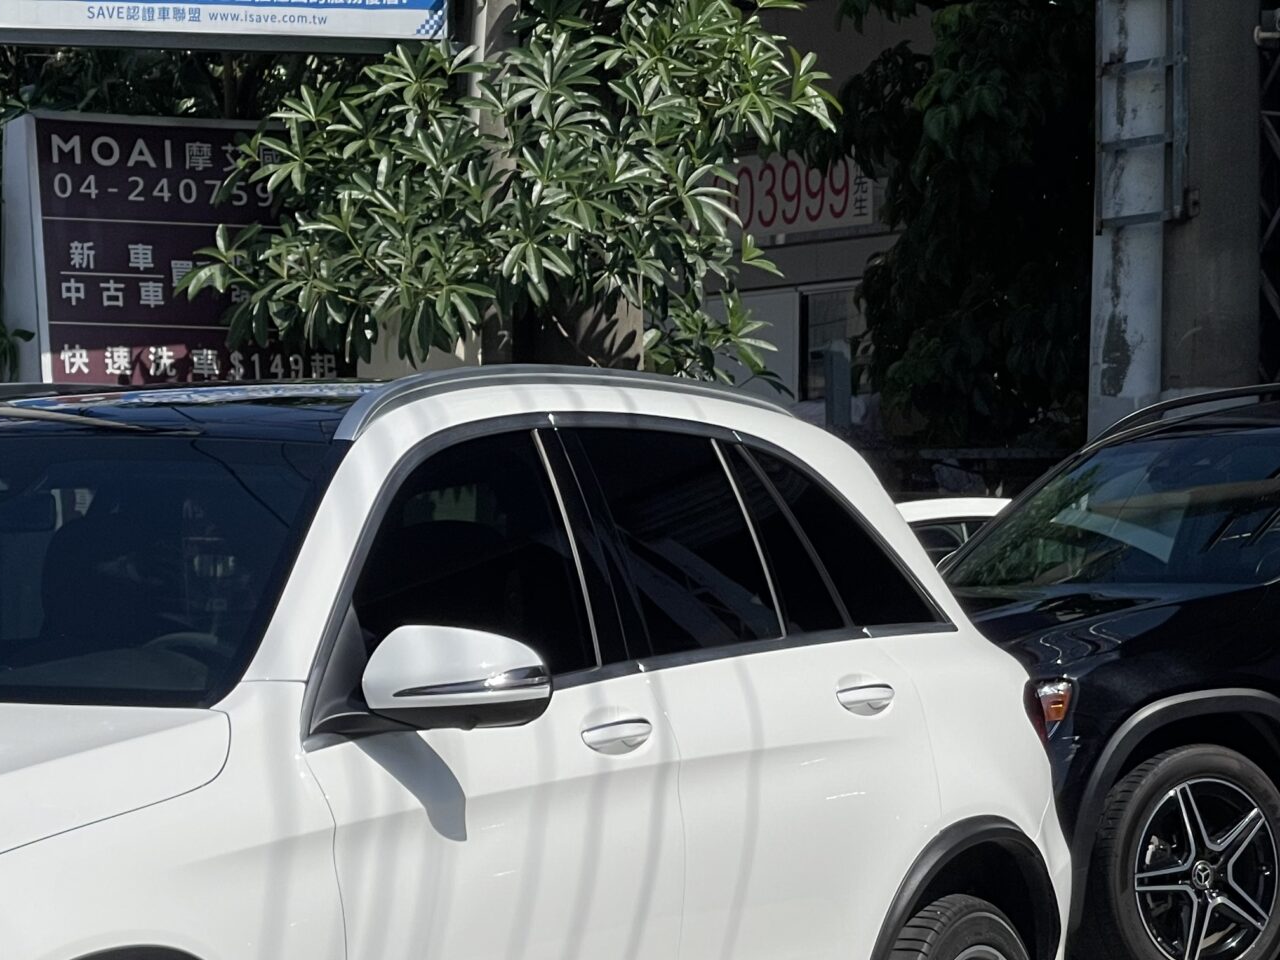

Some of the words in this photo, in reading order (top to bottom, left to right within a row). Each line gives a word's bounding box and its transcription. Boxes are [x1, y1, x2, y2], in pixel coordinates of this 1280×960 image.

[208, 11, 328, 25] www.isave.com.tw
[51, 134, 172, 168] MOAI
[53, 172, 274, 207] 04-240759
[852, 163, 869, 217] 先生
[70, 241, 154, 271] 新車
[61, 279, 165, 308] 中古車
